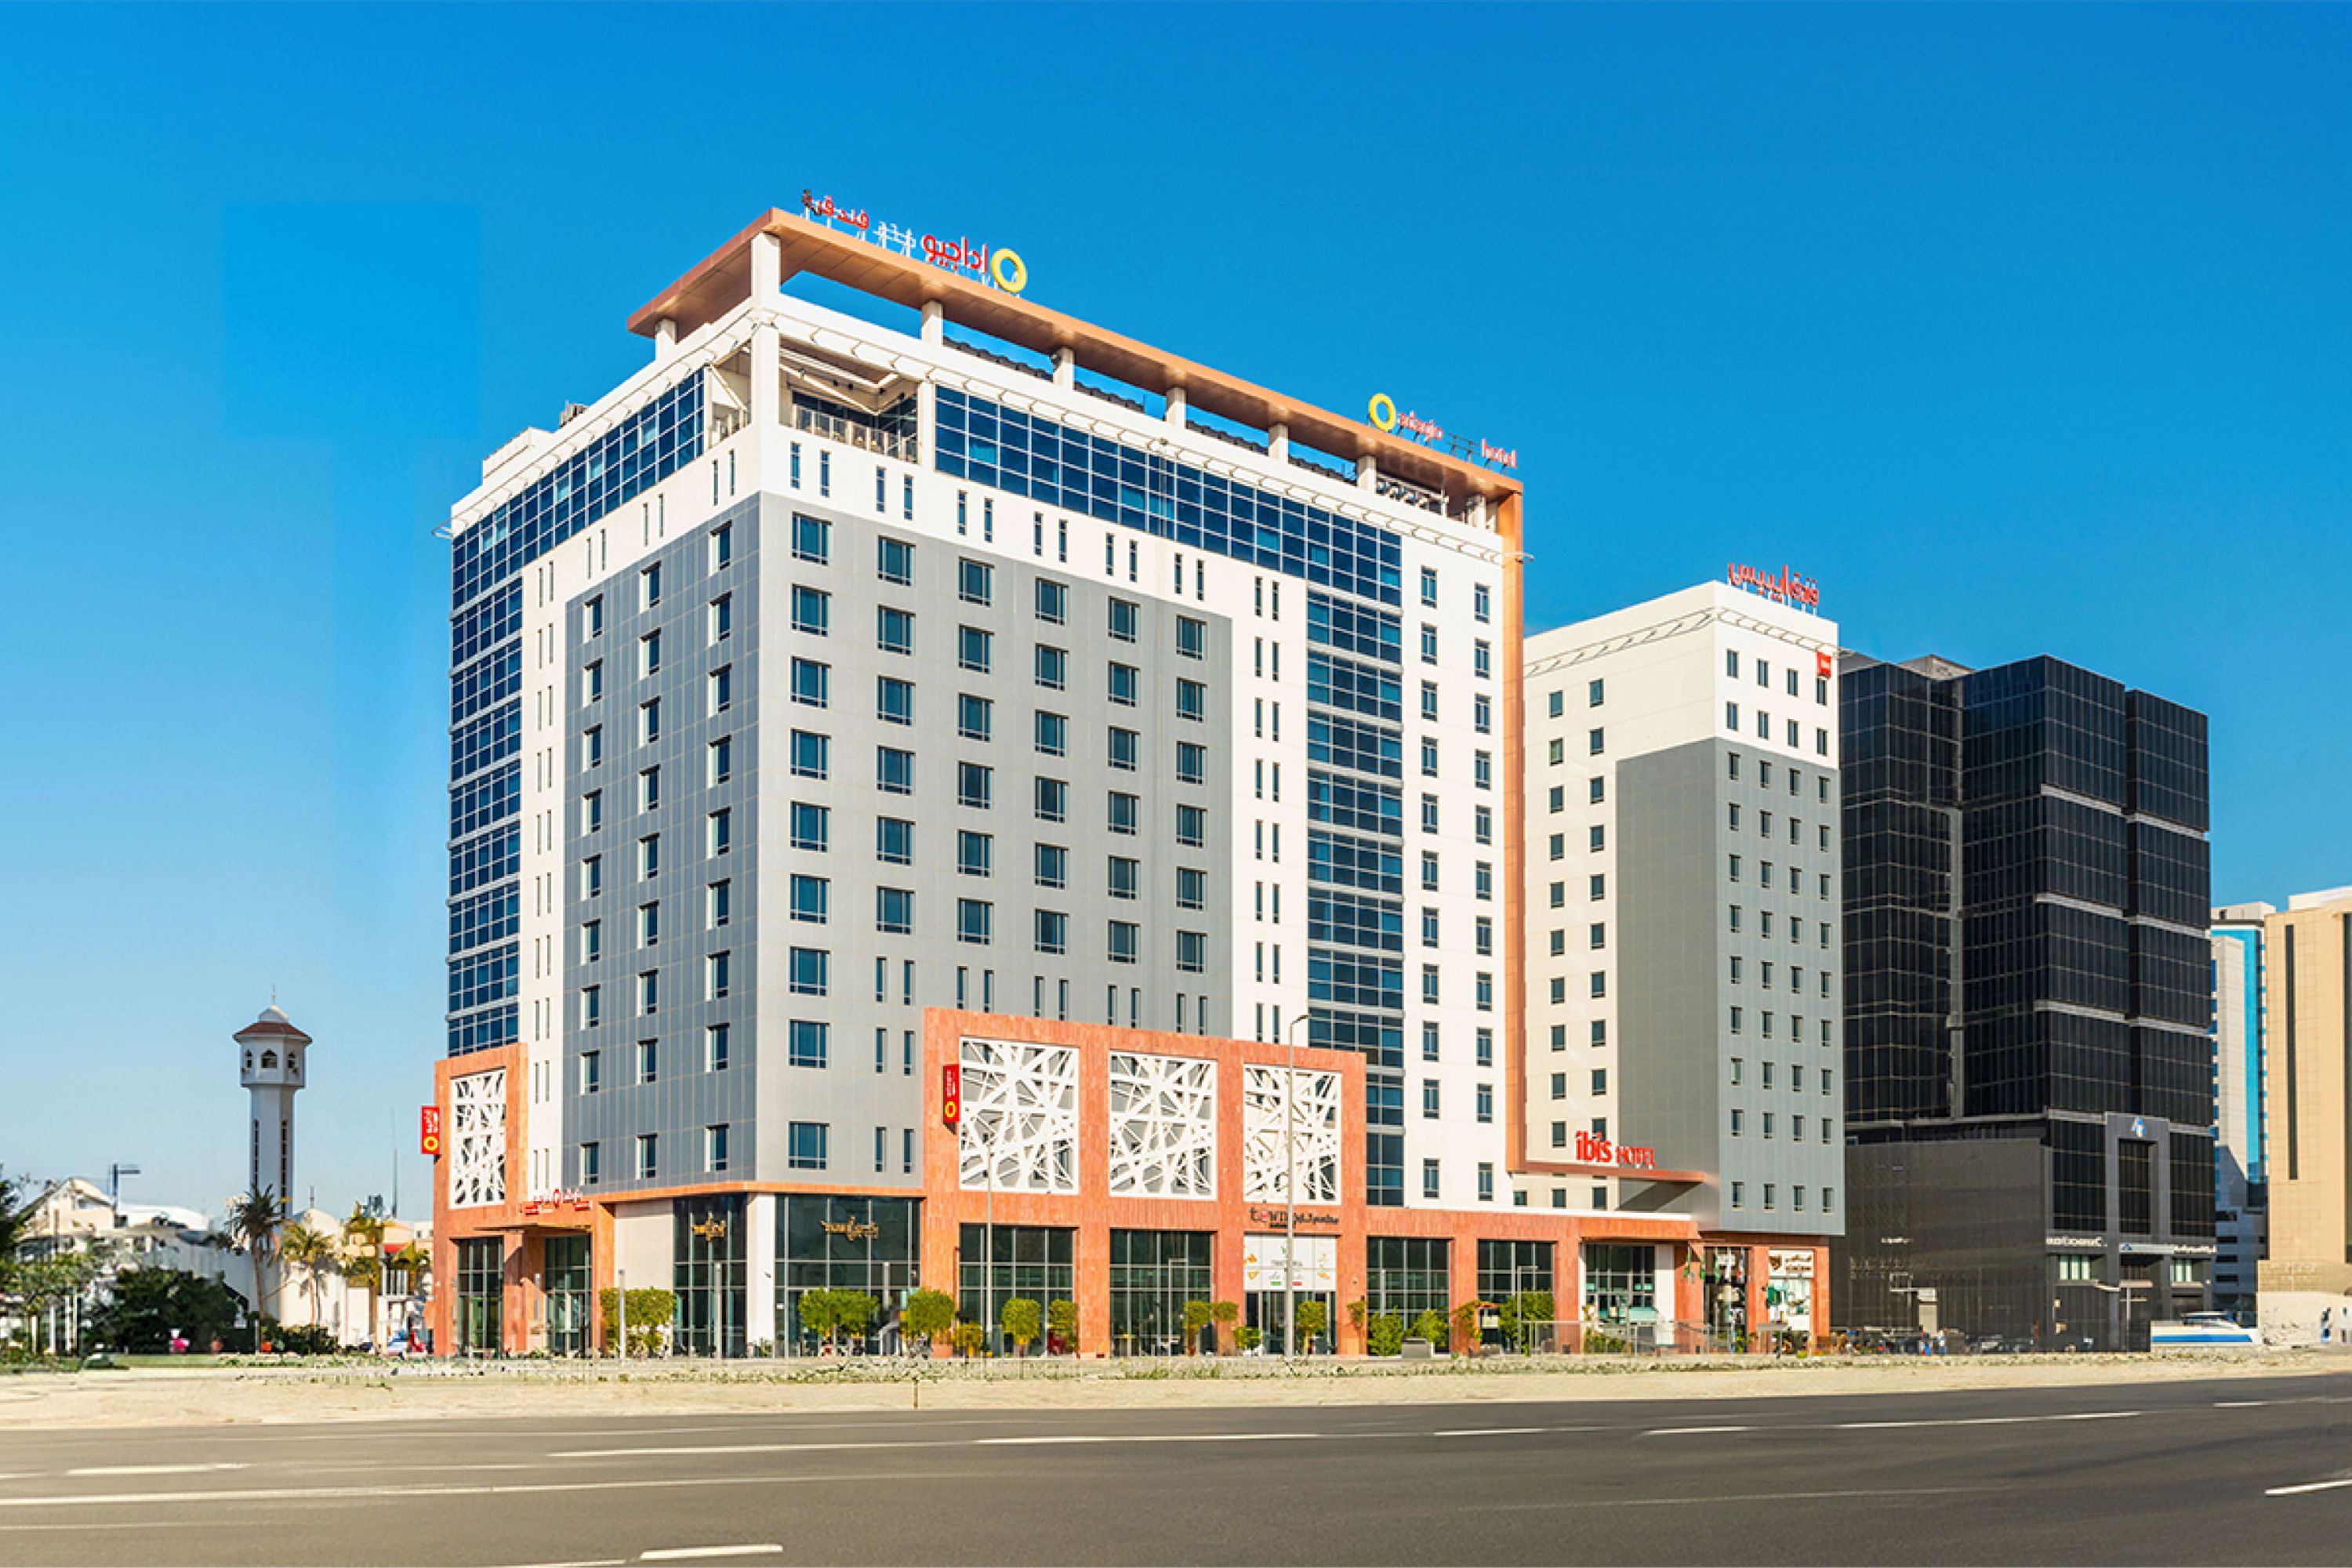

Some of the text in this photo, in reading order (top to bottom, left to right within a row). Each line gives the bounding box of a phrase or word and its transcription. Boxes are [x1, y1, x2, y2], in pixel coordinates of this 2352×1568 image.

[1482, 438, 1517, 469] hotel
[1576, 1130, 1657, 1167] ibis HOTEL
